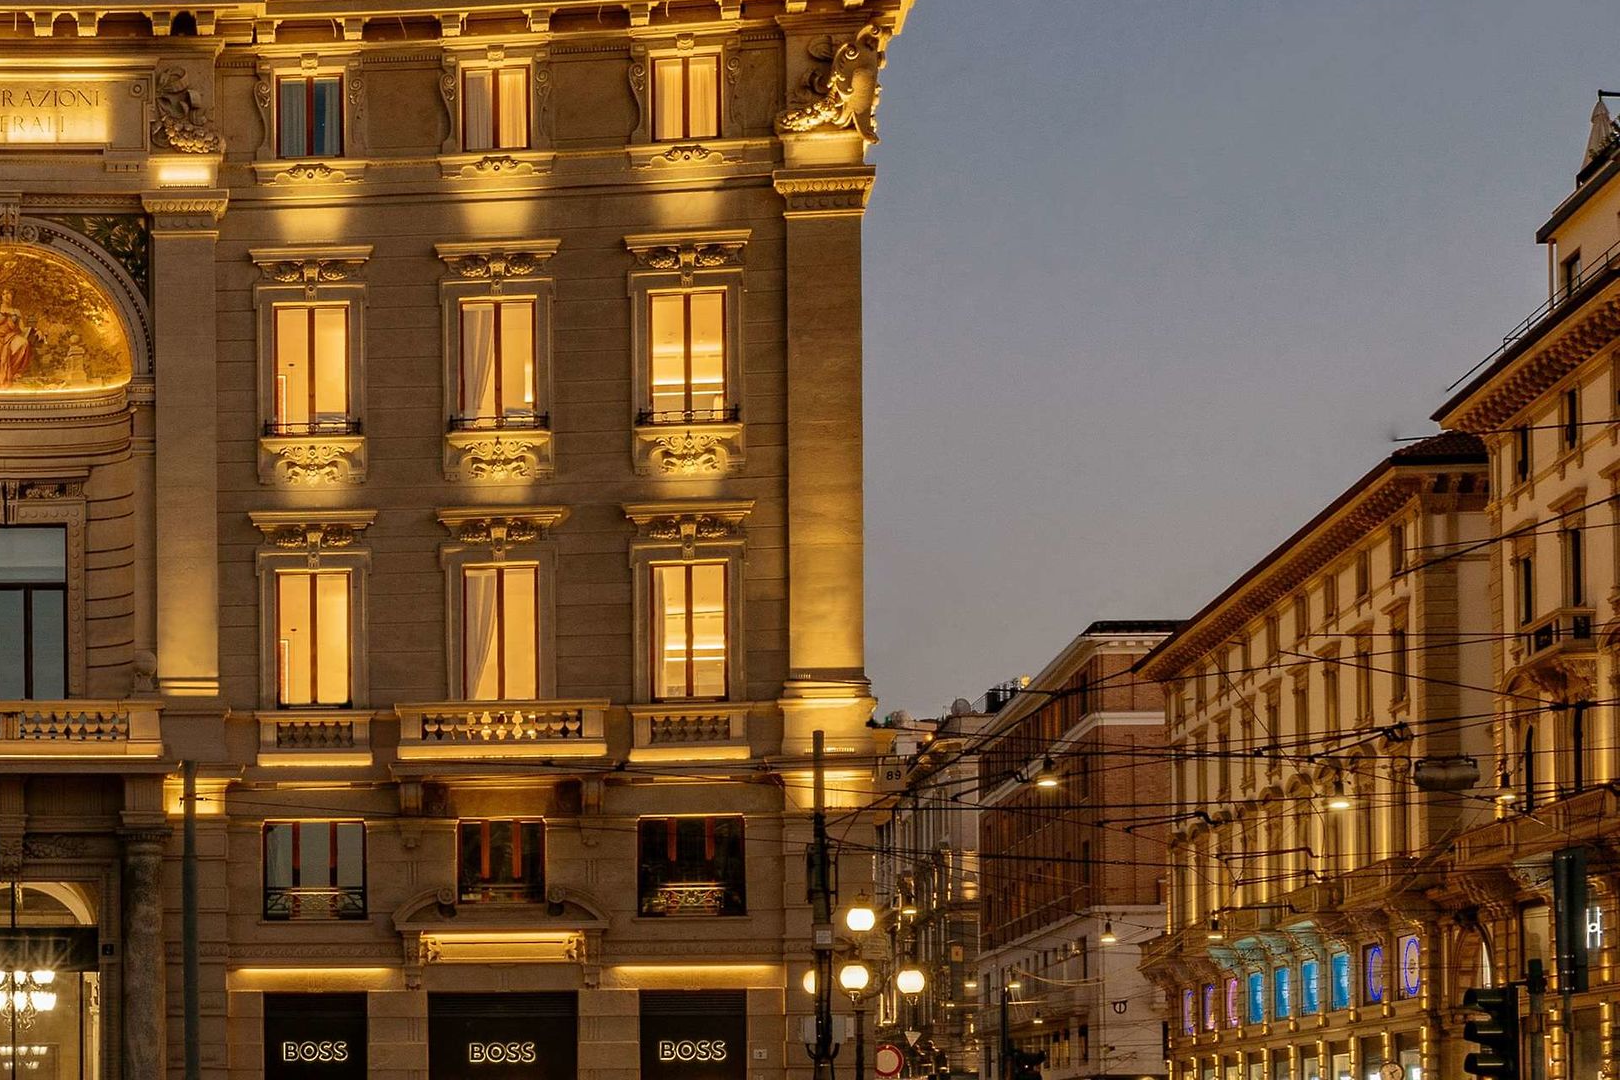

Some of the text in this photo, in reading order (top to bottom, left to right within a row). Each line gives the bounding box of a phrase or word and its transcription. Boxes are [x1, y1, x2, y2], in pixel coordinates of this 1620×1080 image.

[283, 1041, 349, 1061] BOSS
[468, 1041, 536, 1062] BOSS
[659, 1040, 727, 1061] BOSS
